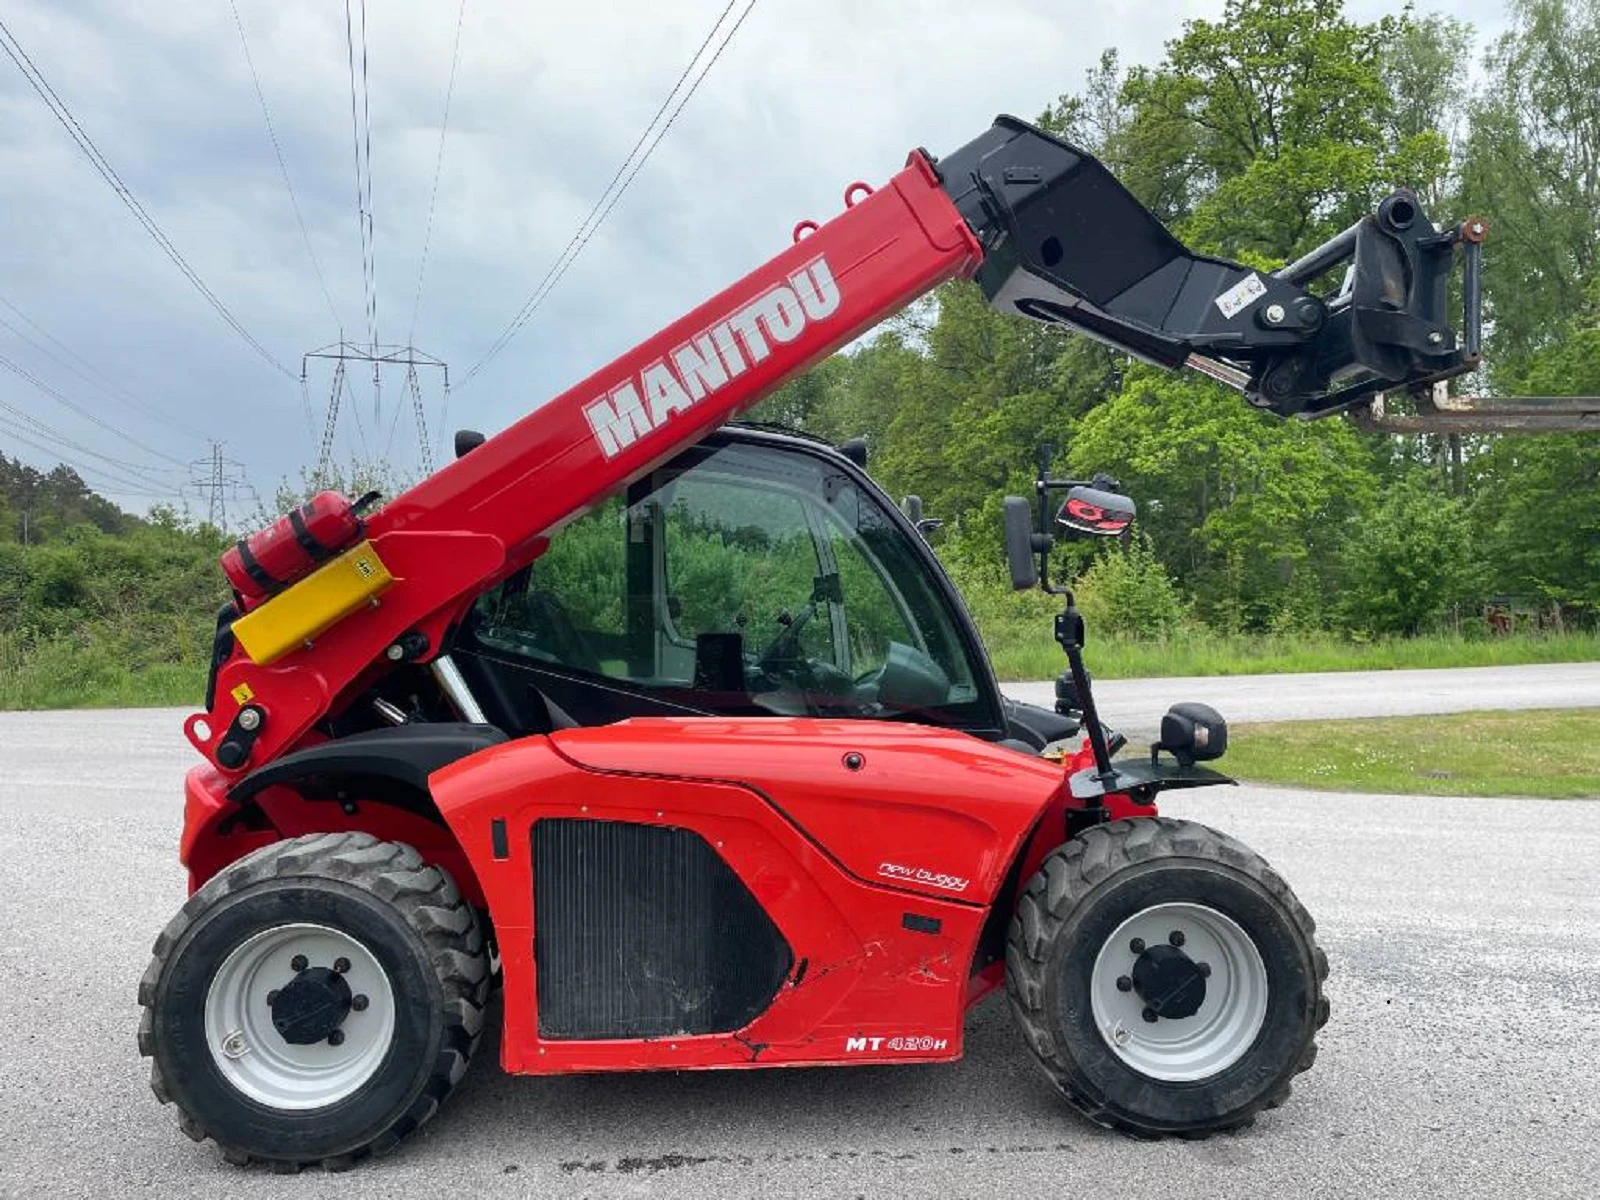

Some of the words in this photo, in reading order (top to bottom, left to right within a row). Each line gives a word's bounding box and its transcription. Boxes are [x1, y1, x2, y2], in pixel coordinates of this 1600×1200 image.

[582, 253, 841, 461] MANITOU
[880, 863, 915, 876] new
[917, 869, 969, 891] buggy
[846, 1037, 885, 1052] MT
